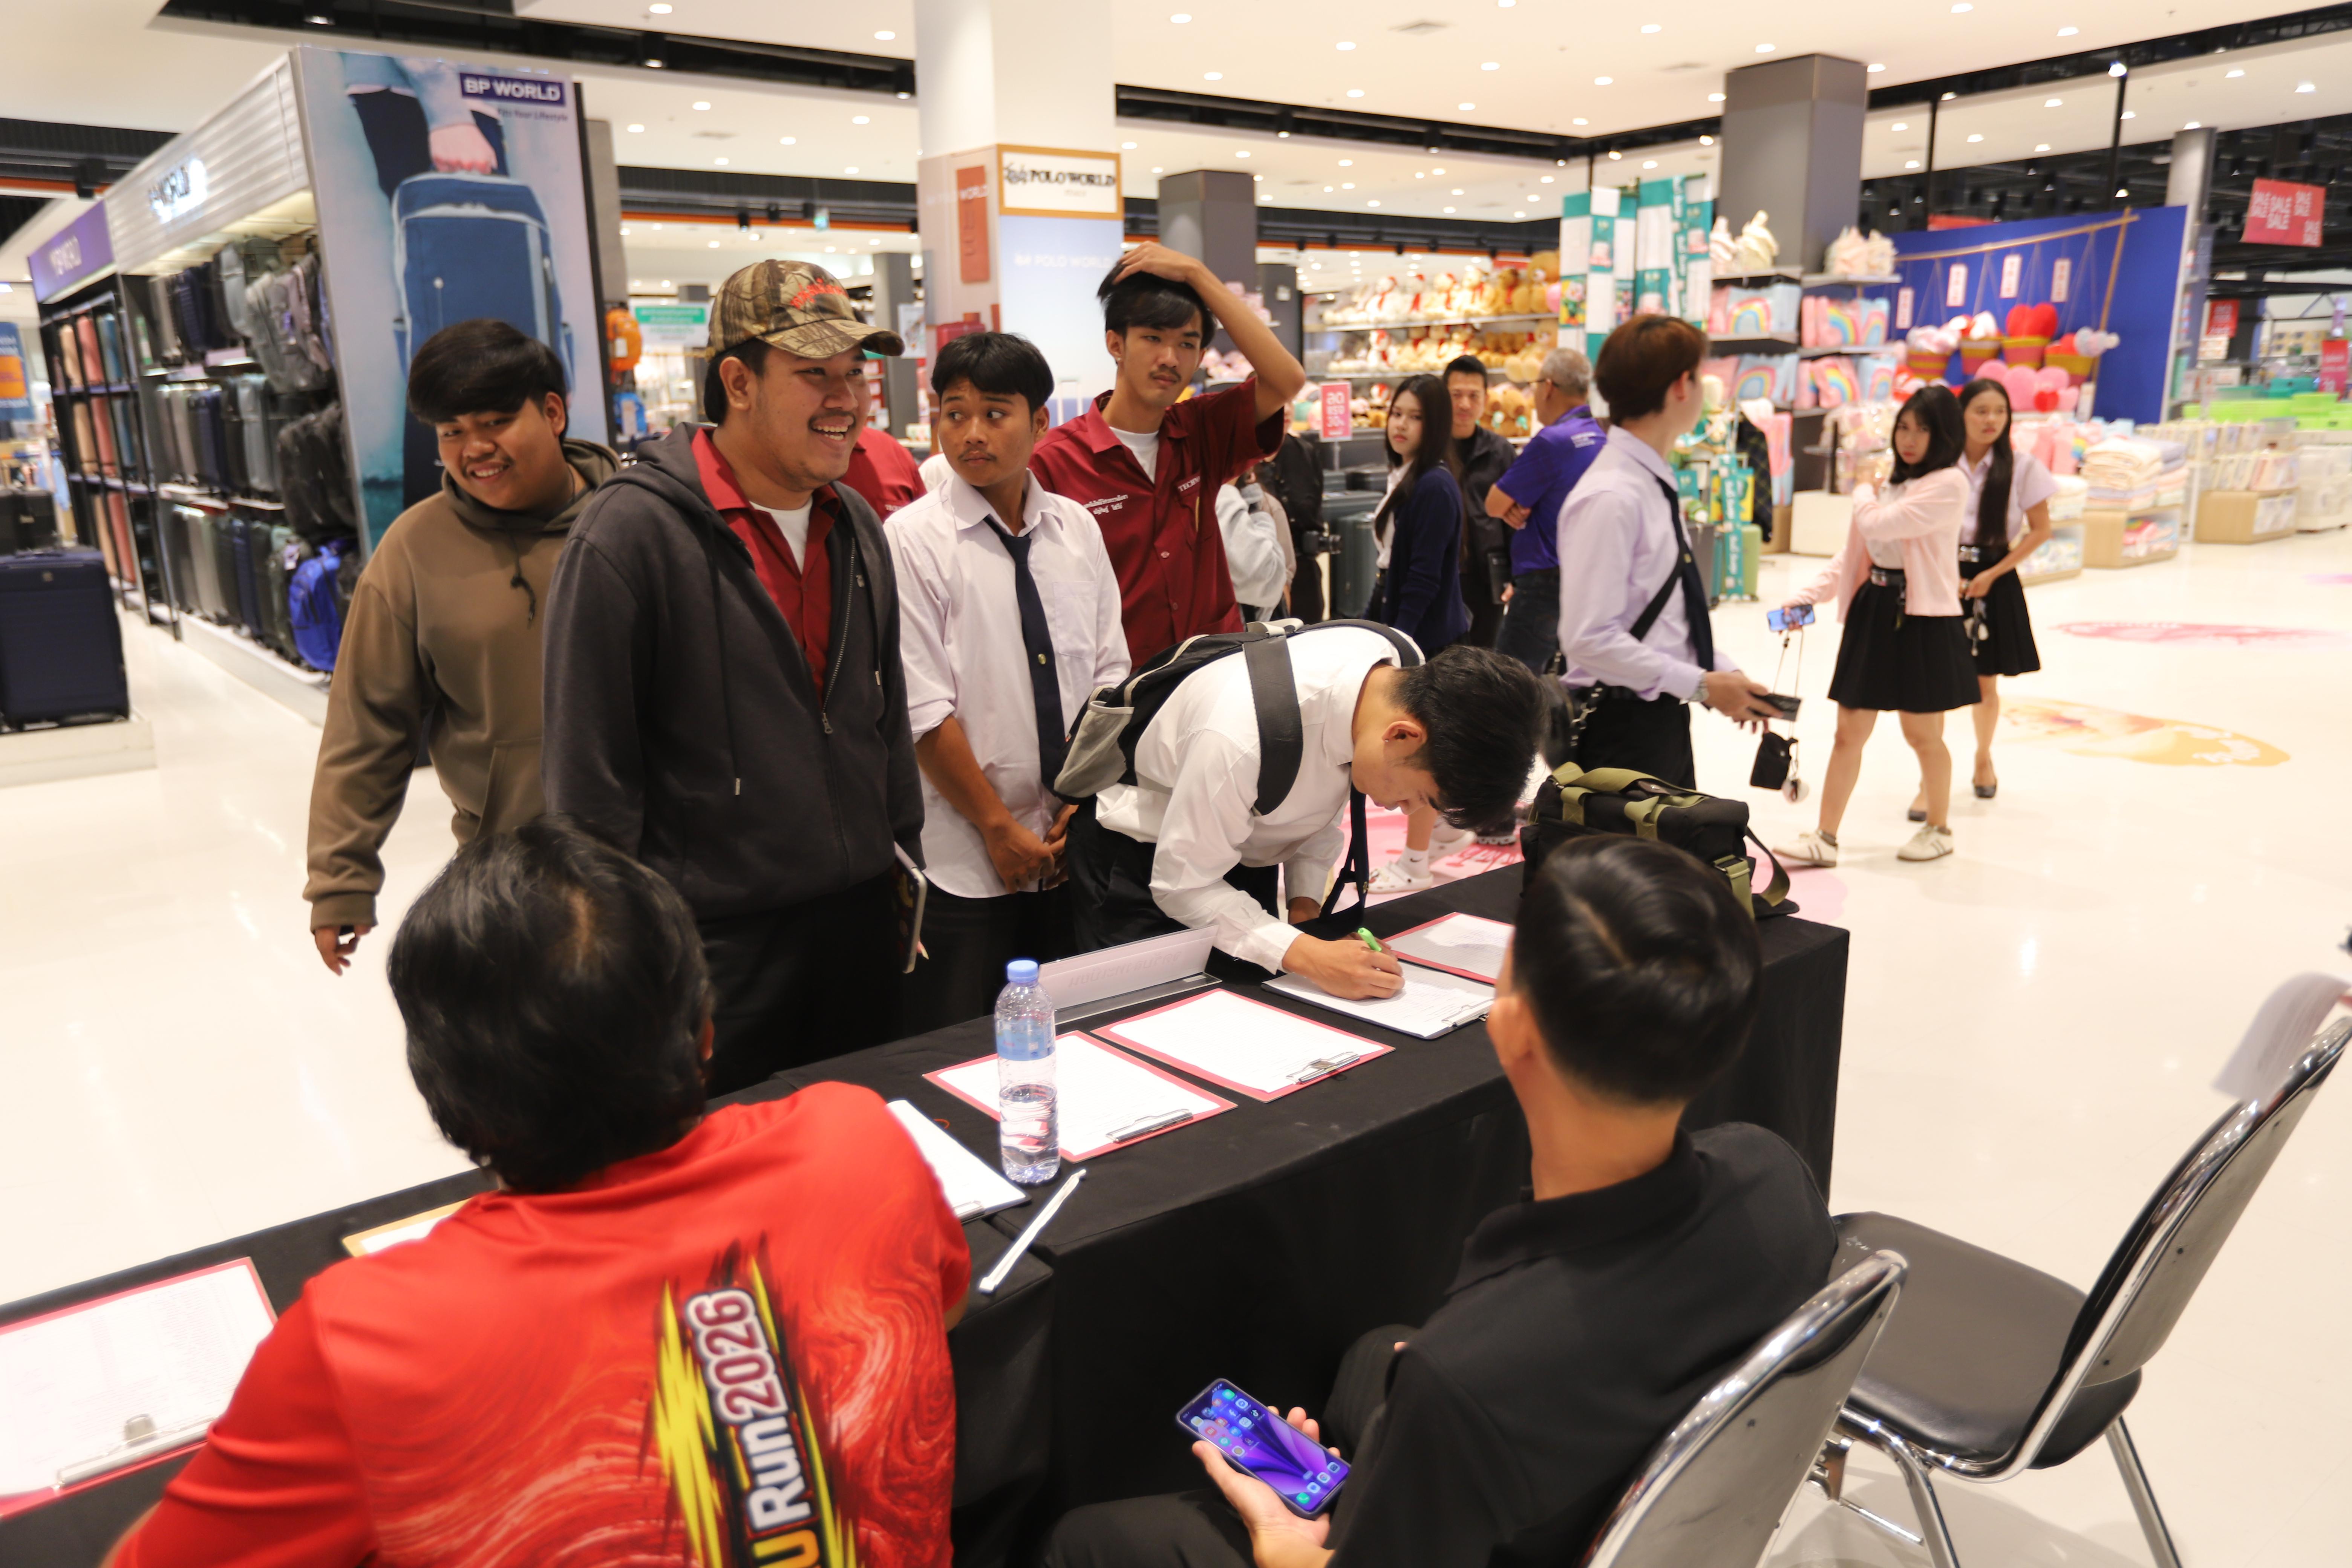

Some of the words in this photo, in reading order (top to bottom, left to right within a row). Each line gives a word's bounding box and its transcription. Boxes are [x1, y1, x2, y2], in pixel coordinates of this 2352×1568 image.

[464, 77, 491, 94] BP
[492, 80, 561, 101] WORLD
[1030, 170, 1066, 184] POLO
[1067, 173, 1116, 187] WORLD
[2270, 195, 2292, 214] SALE
[2267, 213, 2290, 230] SALE
